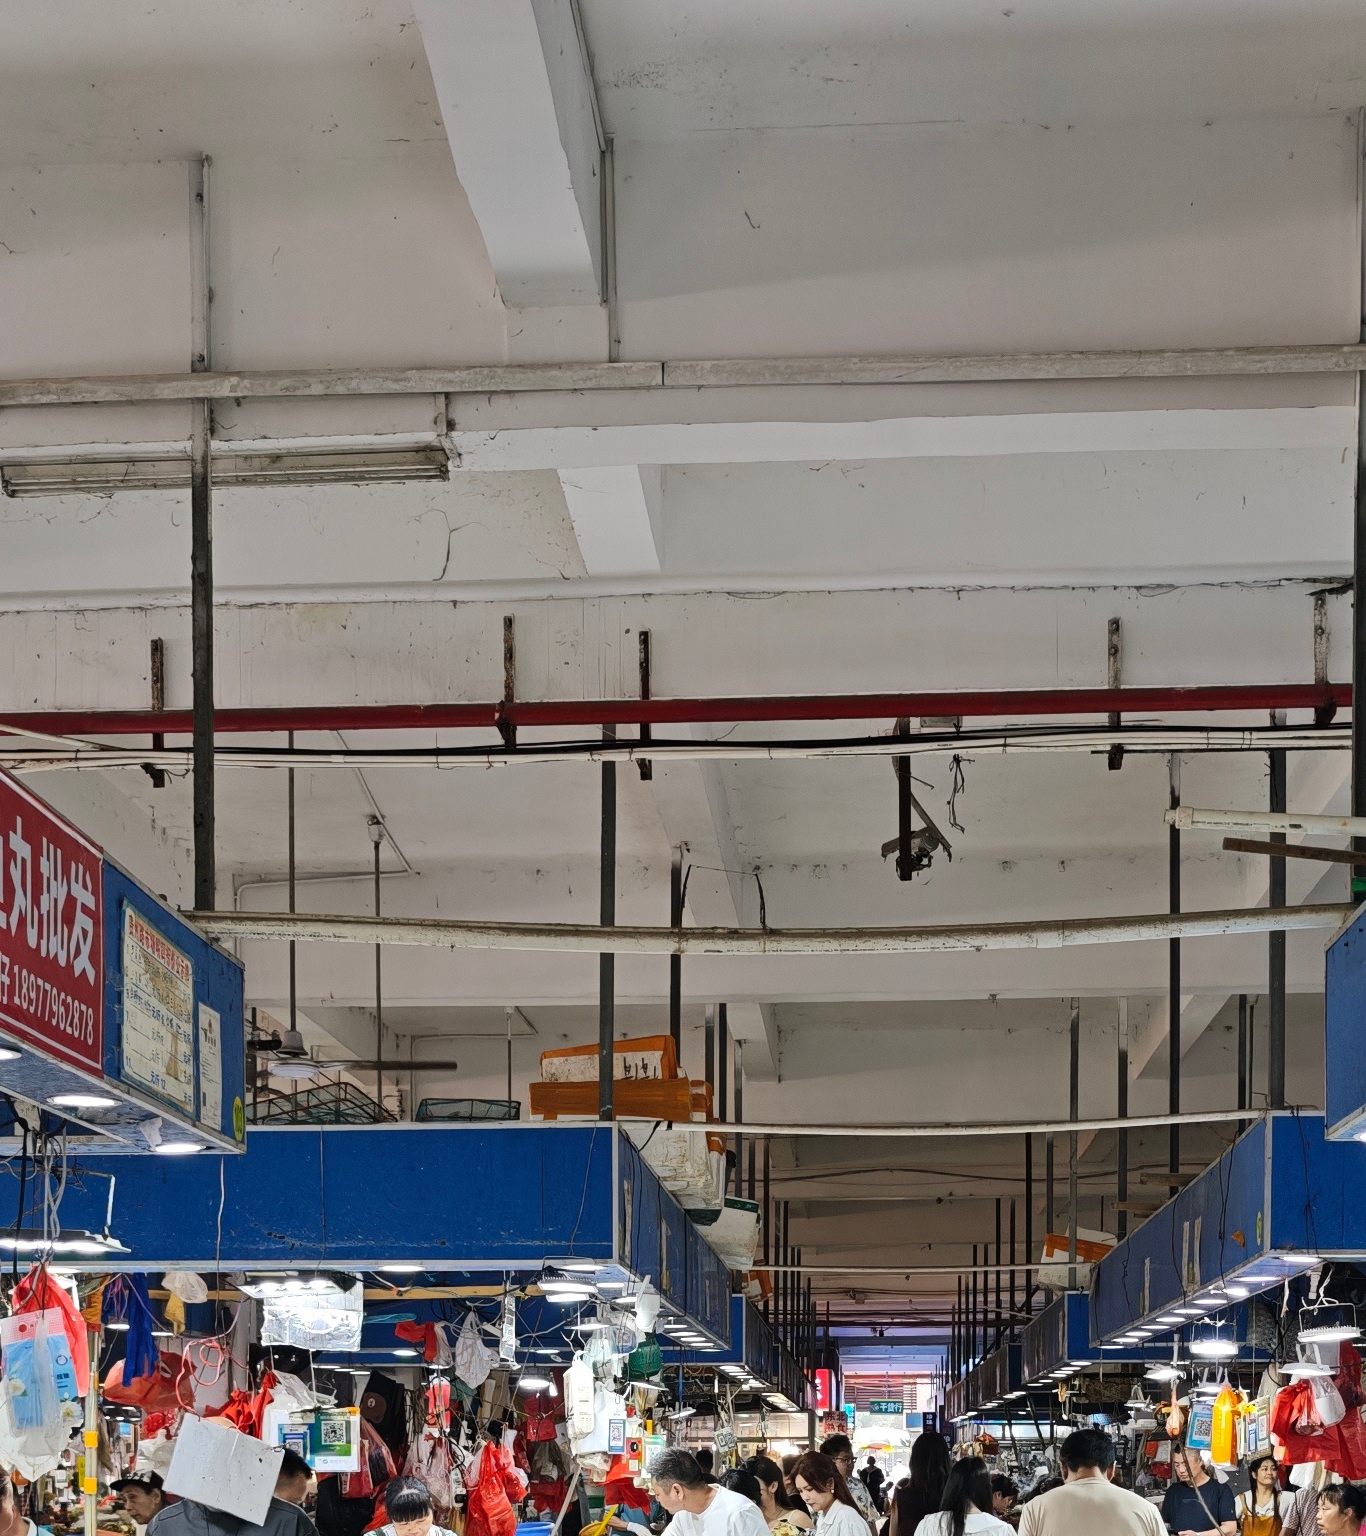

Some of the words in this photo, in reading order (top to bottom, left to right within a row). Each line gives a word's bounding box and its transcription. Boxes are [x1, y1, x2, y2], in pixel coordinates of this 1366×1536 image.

[13, 965, 95, 1047] 18977962878
[879, 1402, 903, 1413] 干货行
